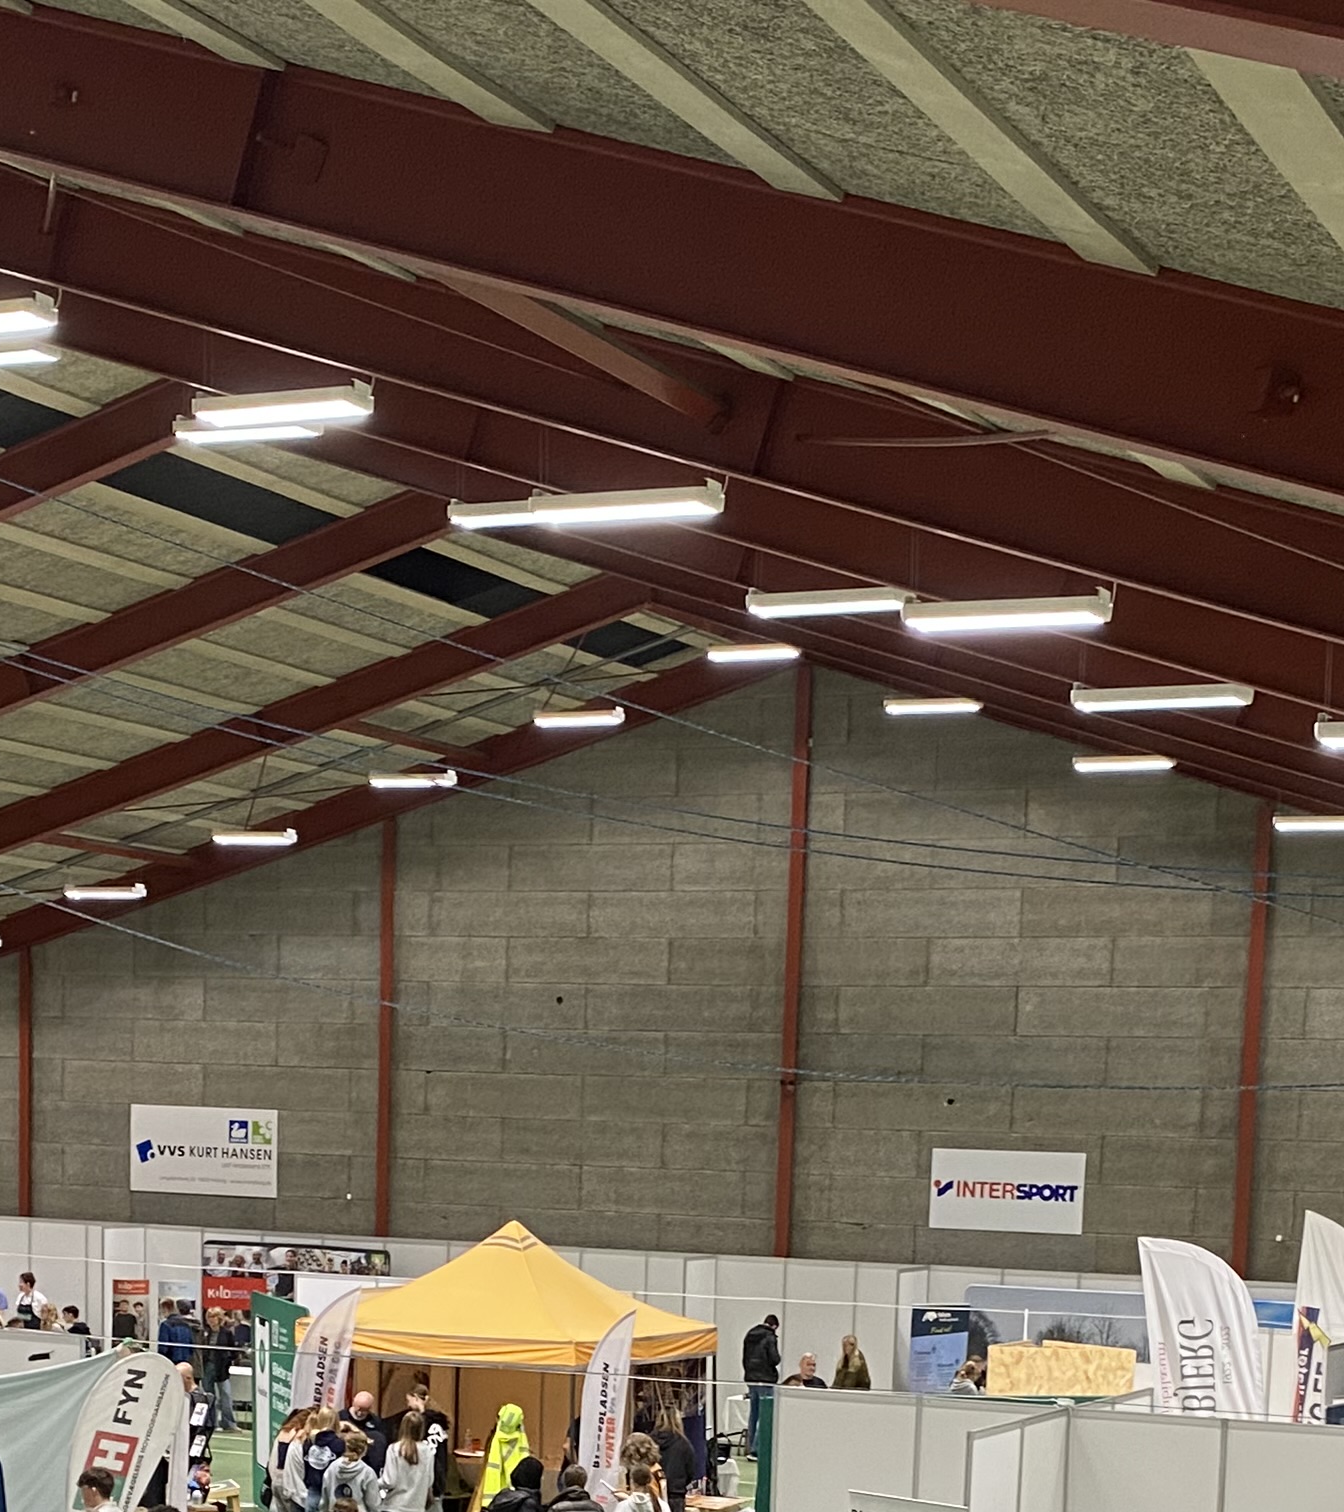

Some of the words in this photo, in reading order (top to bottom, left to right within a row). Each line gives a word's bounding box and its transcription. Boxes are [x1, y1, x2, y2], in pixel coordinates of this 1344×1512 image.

[158, 1144, 185, 1157] VVS
[189, 1146, 218, 1158] KURT
[222, 1148, 272, 1160] HANSEN
[956, 1180, 1079, 1202] INTERSPORT
[313, 1336, 328, 1407] EPLADSEN
[112, 1368, 147, 1426] FYN
